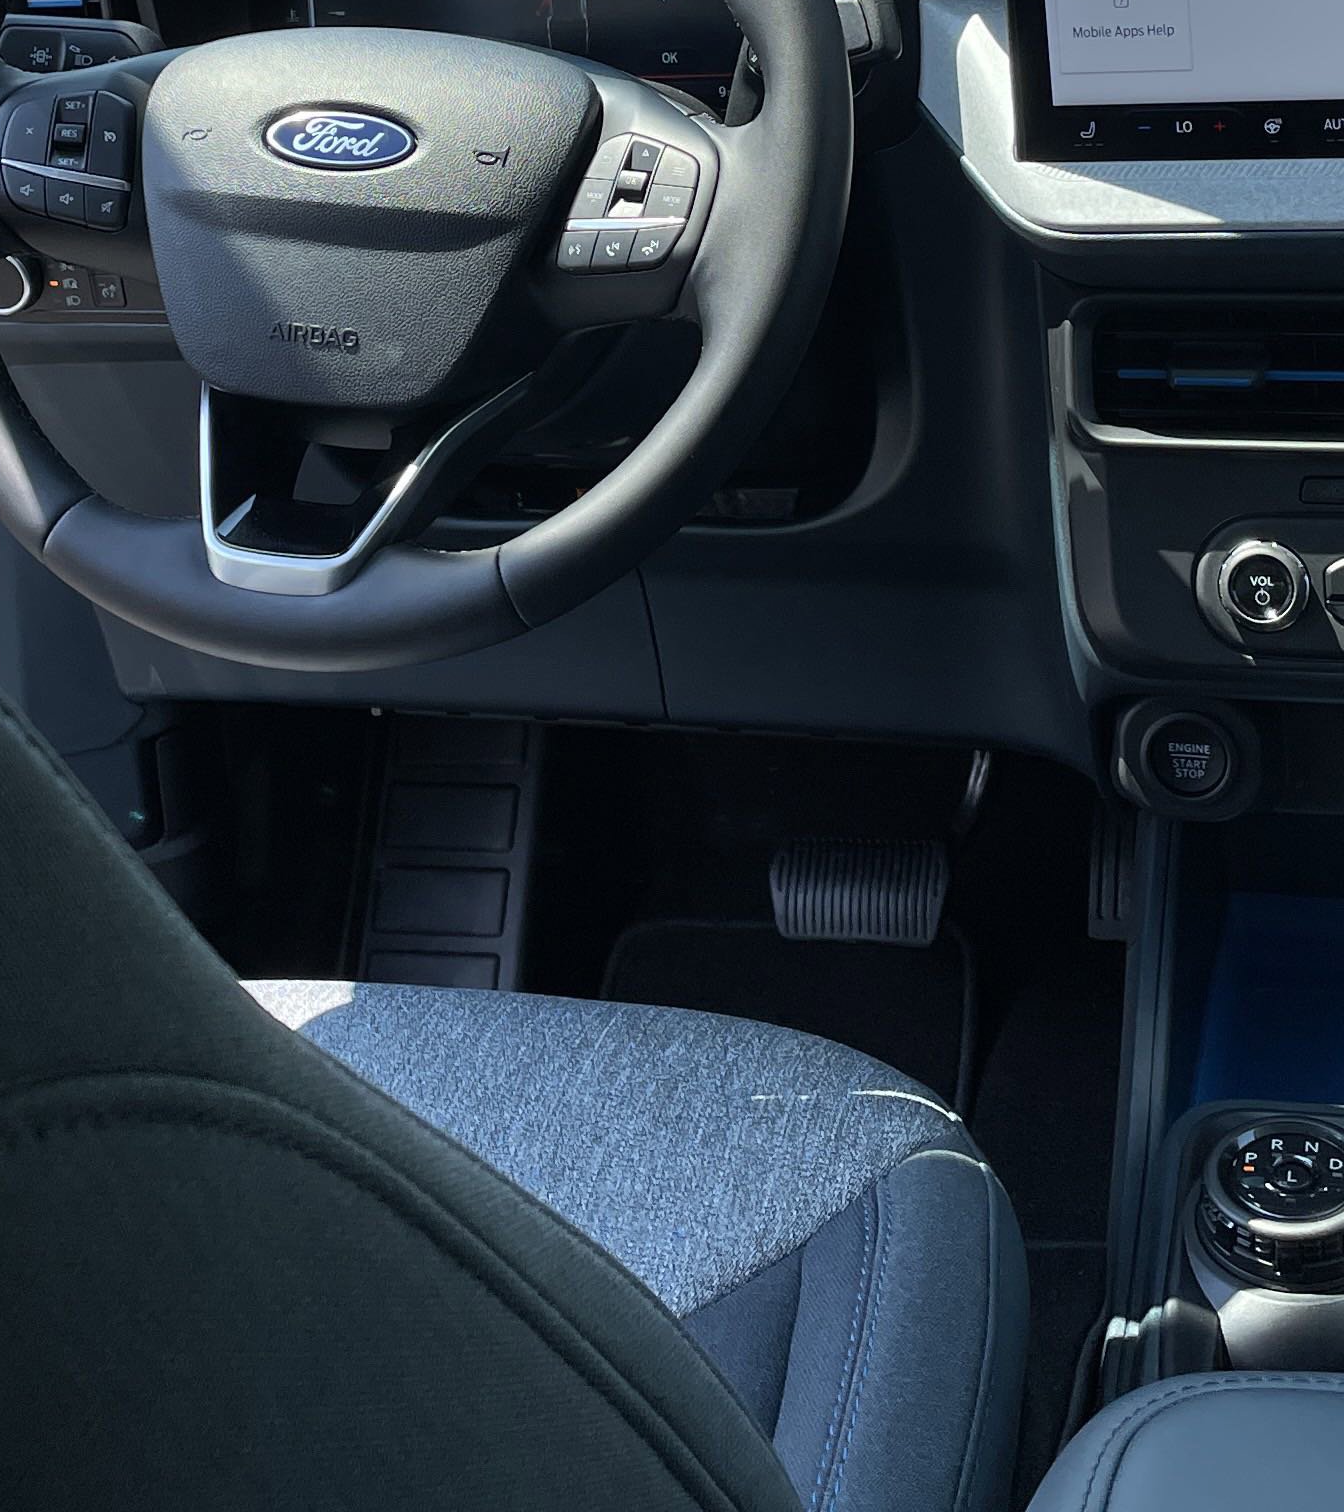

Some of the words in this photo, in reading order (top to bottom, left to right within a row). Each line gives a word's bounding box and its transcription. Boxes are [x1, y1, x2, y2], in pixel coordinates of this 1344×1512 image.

[1072, 26, 1112, 39] Mobile
[1113, 26, 1145, 39] Apps
[1146, 24, 1175, 38] Help
[661, 52, 678, 64] OK
[1175, 120, 1193, 133] LO
[61, 129, 78, 138] RES
[292, 117, 385, 157] Ford
[269, 320, 359, 350] AIRBAG
[1249, 575, 1275, 588] VOL
[1168, 742, 1211, 755] ENGINE
[1172, 758, 1207, 770] START
[1175, 768, 1205, 780] STOP
[1271, 1139, 1284, 1151] R
[1304, 1140, 1320, 1153] N
[1244, 1152, 1259, 1164] P
[1329, 1157, 1344, 1170] D
[1287, 1170, 1298, 1182] L
